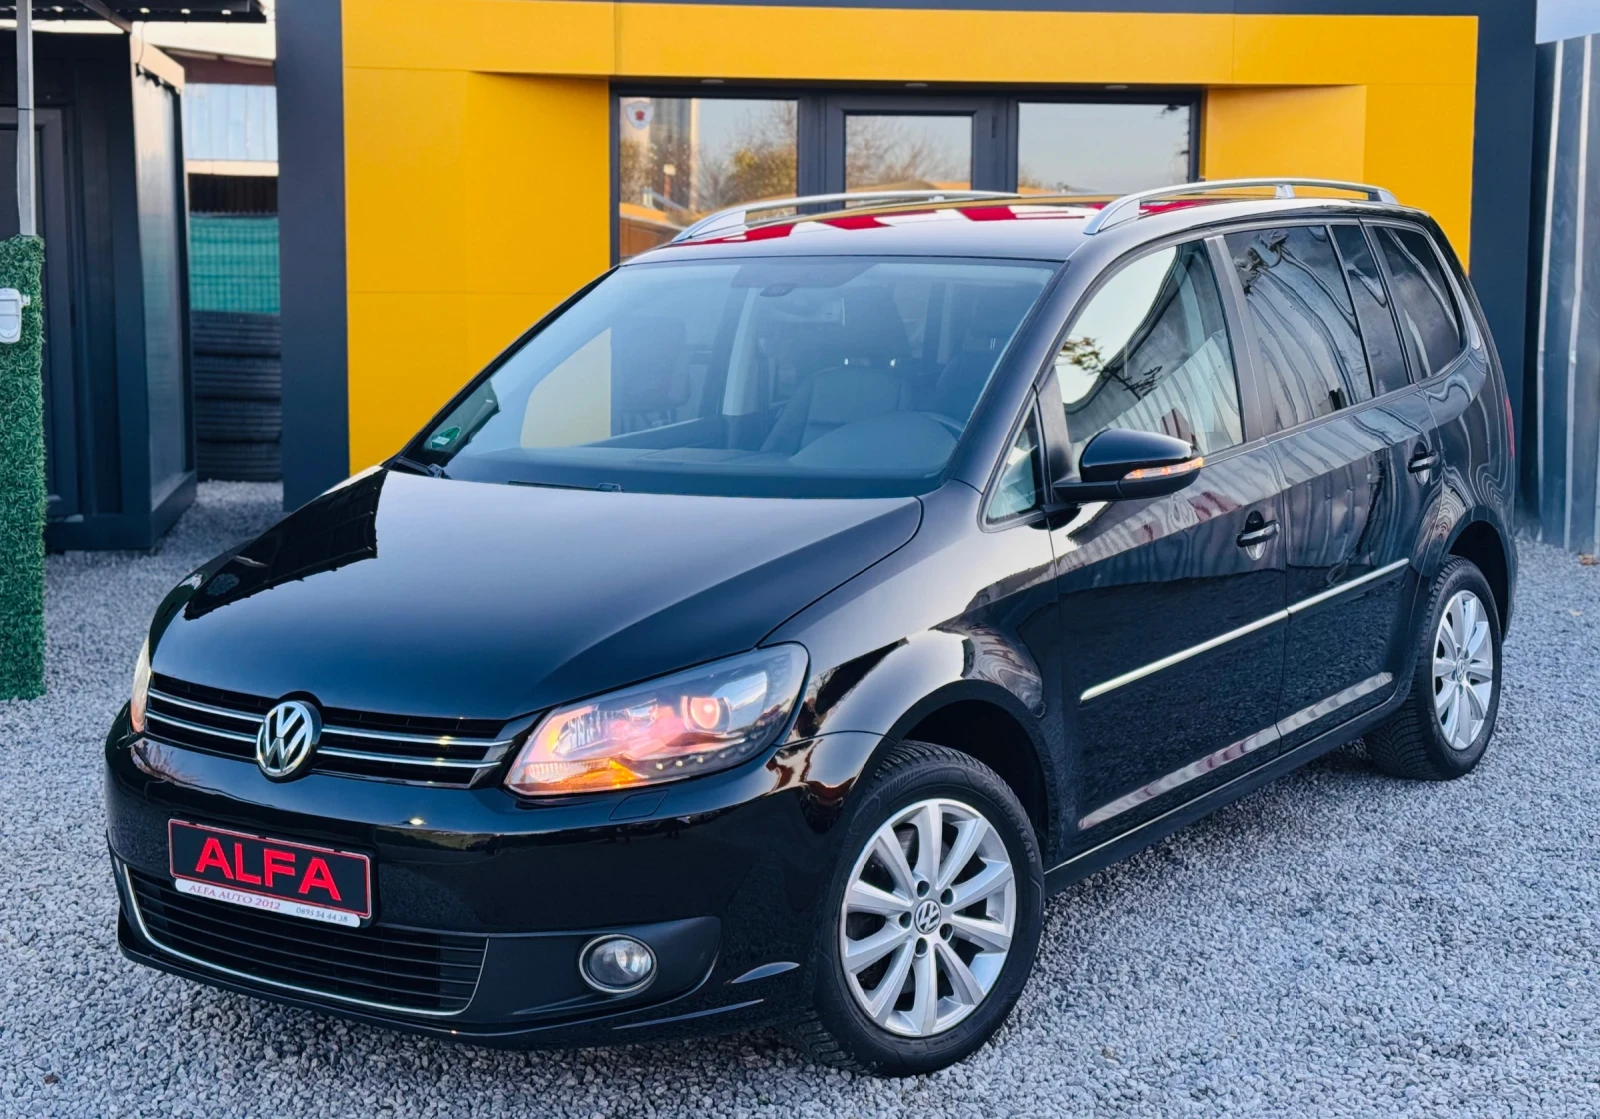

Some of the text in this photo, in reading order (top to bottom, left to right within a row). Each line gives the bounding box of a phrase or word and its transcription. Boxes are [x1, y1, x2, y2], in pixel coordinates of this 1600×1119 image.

[258, 702, 312, 774] VW
[195, 837, 342, 901] ALFA
[189, 884, 280, 910] ALFA AUTO 2012
[327, 912, 337, 921] 44
